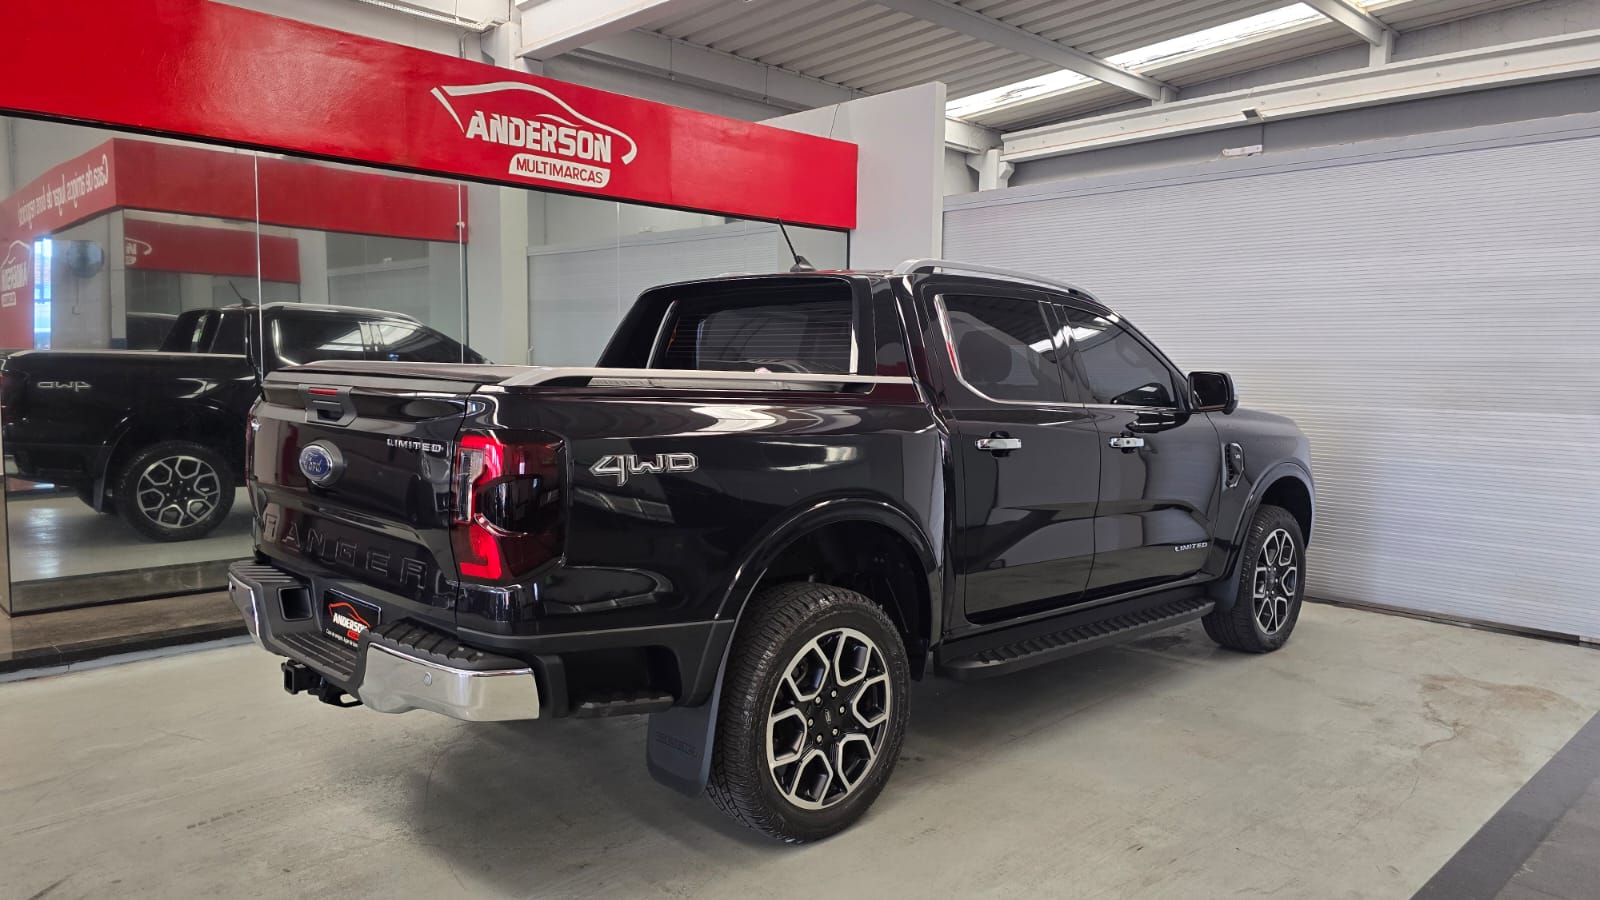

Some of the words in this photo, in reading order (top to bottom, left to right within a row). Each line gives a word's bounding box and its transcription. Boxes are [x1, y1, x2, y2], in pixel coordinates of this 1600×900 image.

[466, 110, 611, 163] ANDERSON
[516, 156, 603, 184] MULTIMARCAS
[386, 438, 442, 453] LIMITED
[589, 453, 698, 486] 4WD
[263, 512, 428, 590] RANGER
